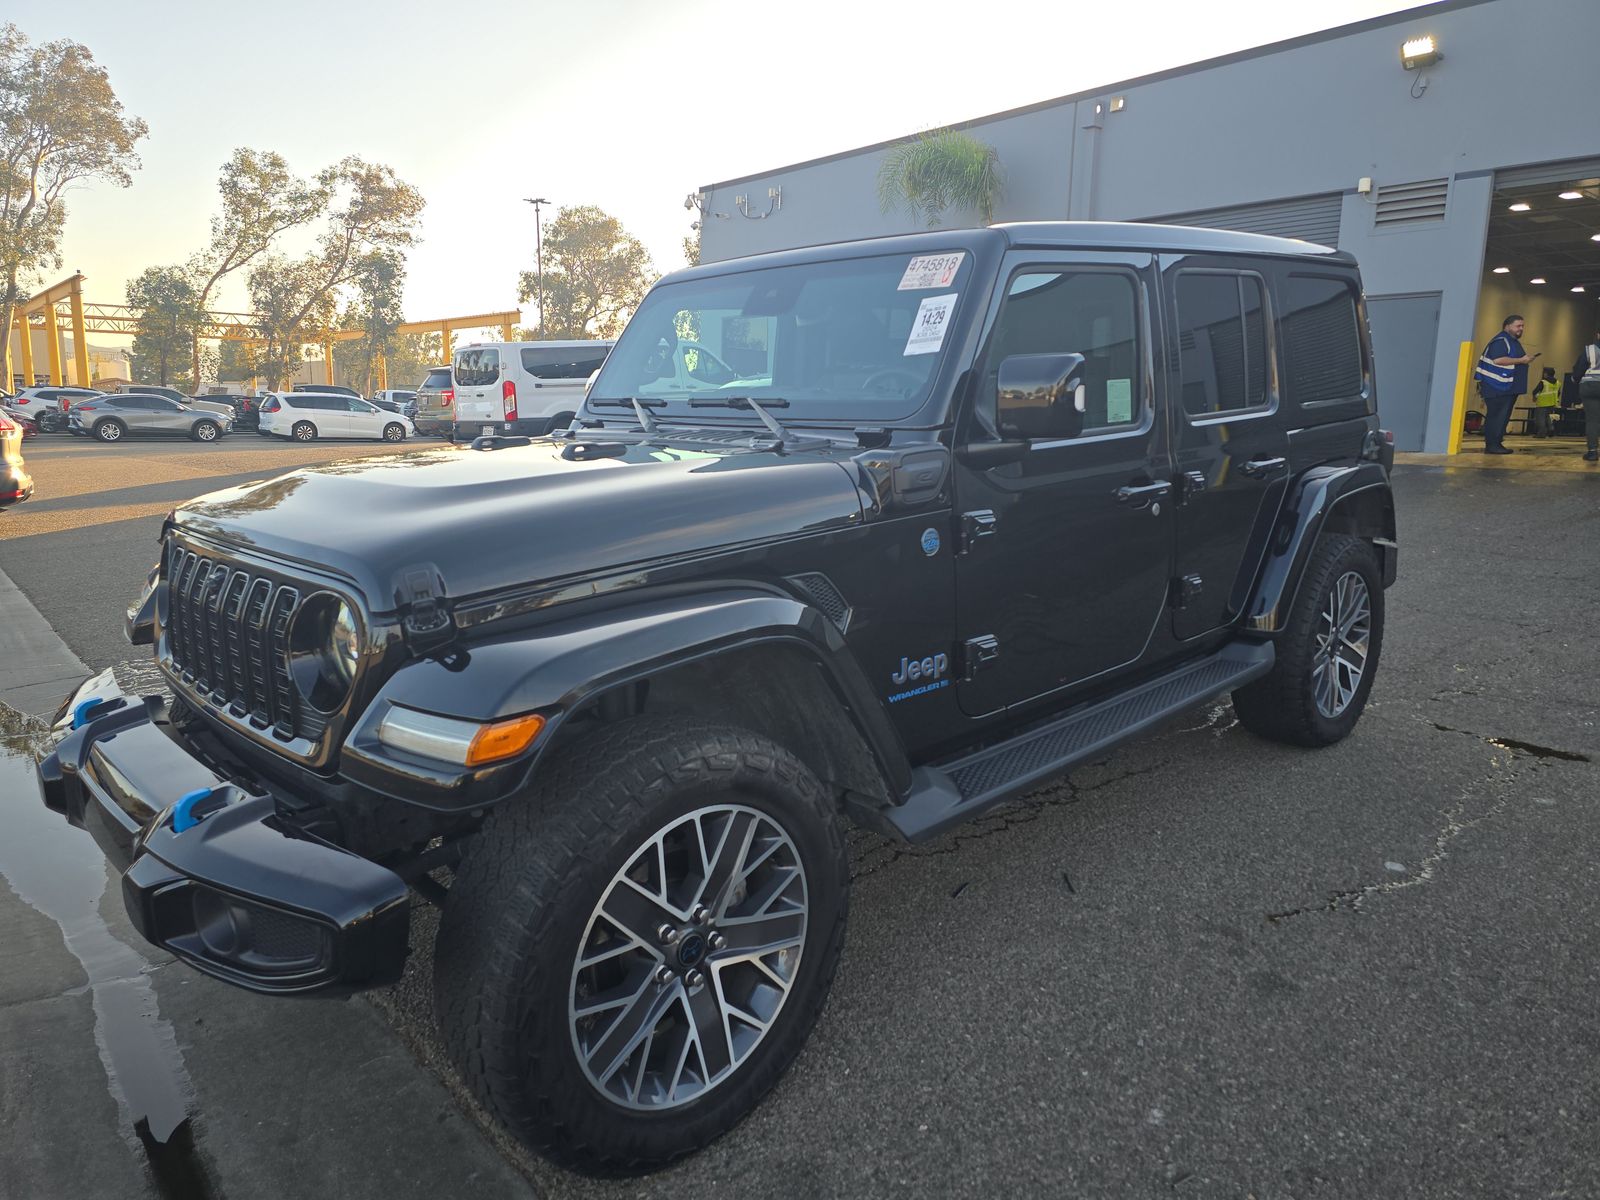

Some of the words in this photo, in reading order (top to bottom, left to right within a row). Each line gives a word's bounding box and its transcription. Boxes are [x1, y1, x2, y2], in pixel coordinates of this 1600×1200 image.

[921, 310, 946, 327] 14:29
[892, 653, 948, 685] Jeep
[888, 682, 940, 703] WRANGLER
